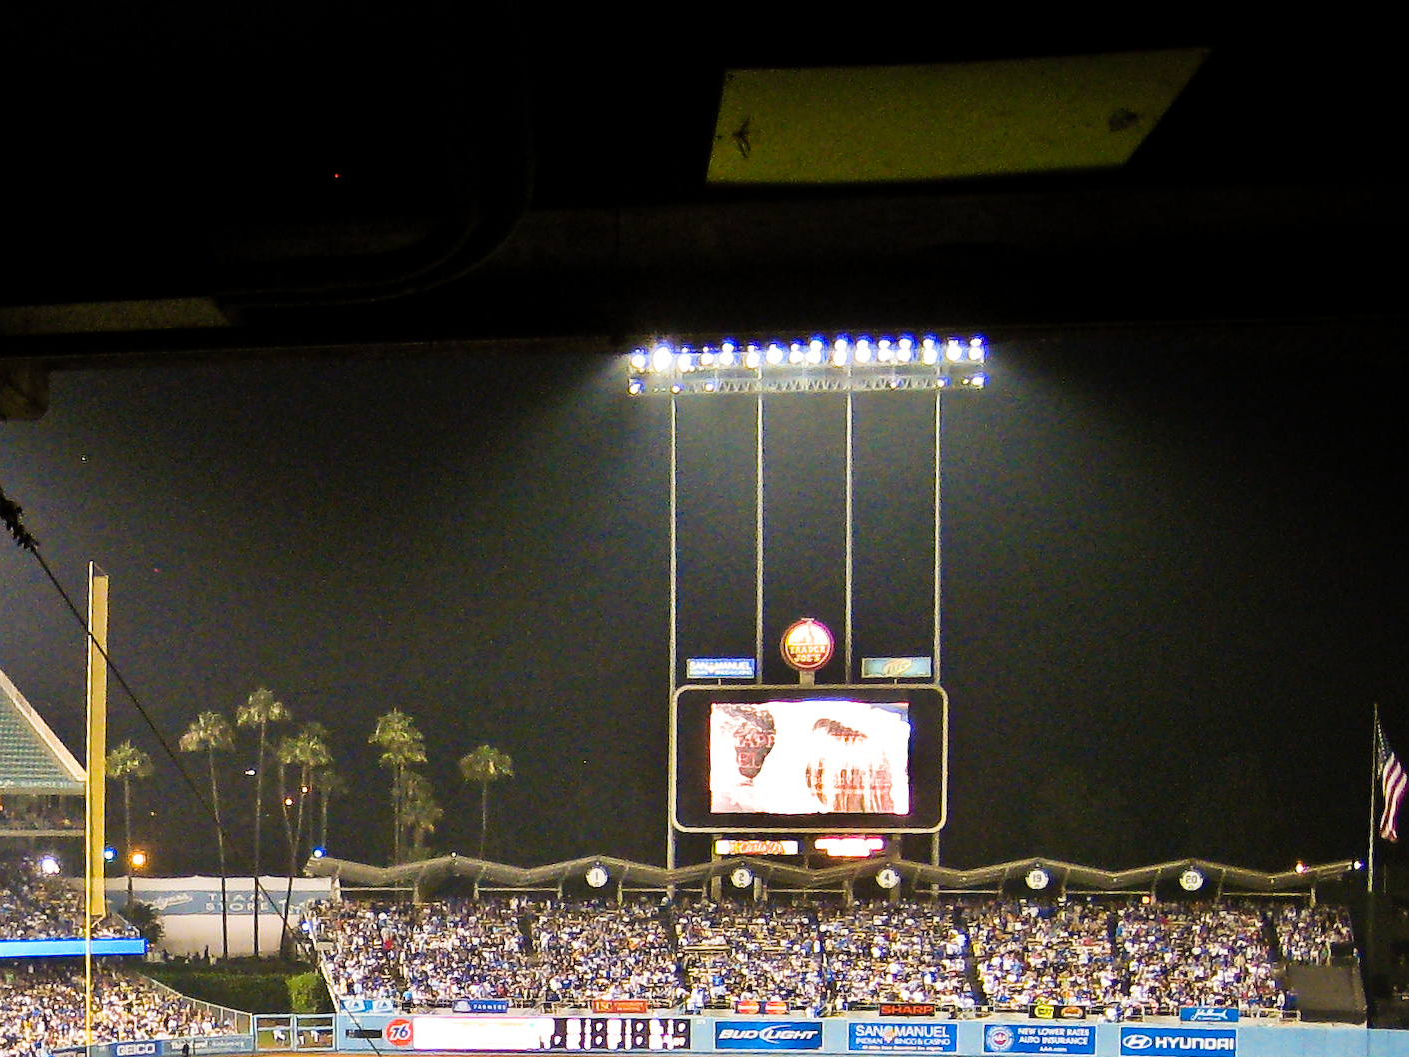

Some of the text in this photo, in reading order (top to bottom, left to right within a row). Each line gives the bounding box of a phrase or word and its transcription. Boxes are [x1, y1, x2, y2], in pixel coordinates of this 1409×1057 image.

[789, 645, 826, 654] TRADER
[794, 653, 821, 662] JOE'S
[881, 1005, 933, 1014] SHARP
[391, 1025, 409, 1039] 76
[719, 1029, 818, 1040] BUD LIGHT
[855, 1025, 950, 1037] SAN MANUEL
[1038, 1028, 1065, 1036] LOWER
[1042, 1037, 1088, 1045] INSURANCE
[1155, 1036, 1234, 1050] HYUNDAI
[116, 1043, 156, 1056] GEICO
